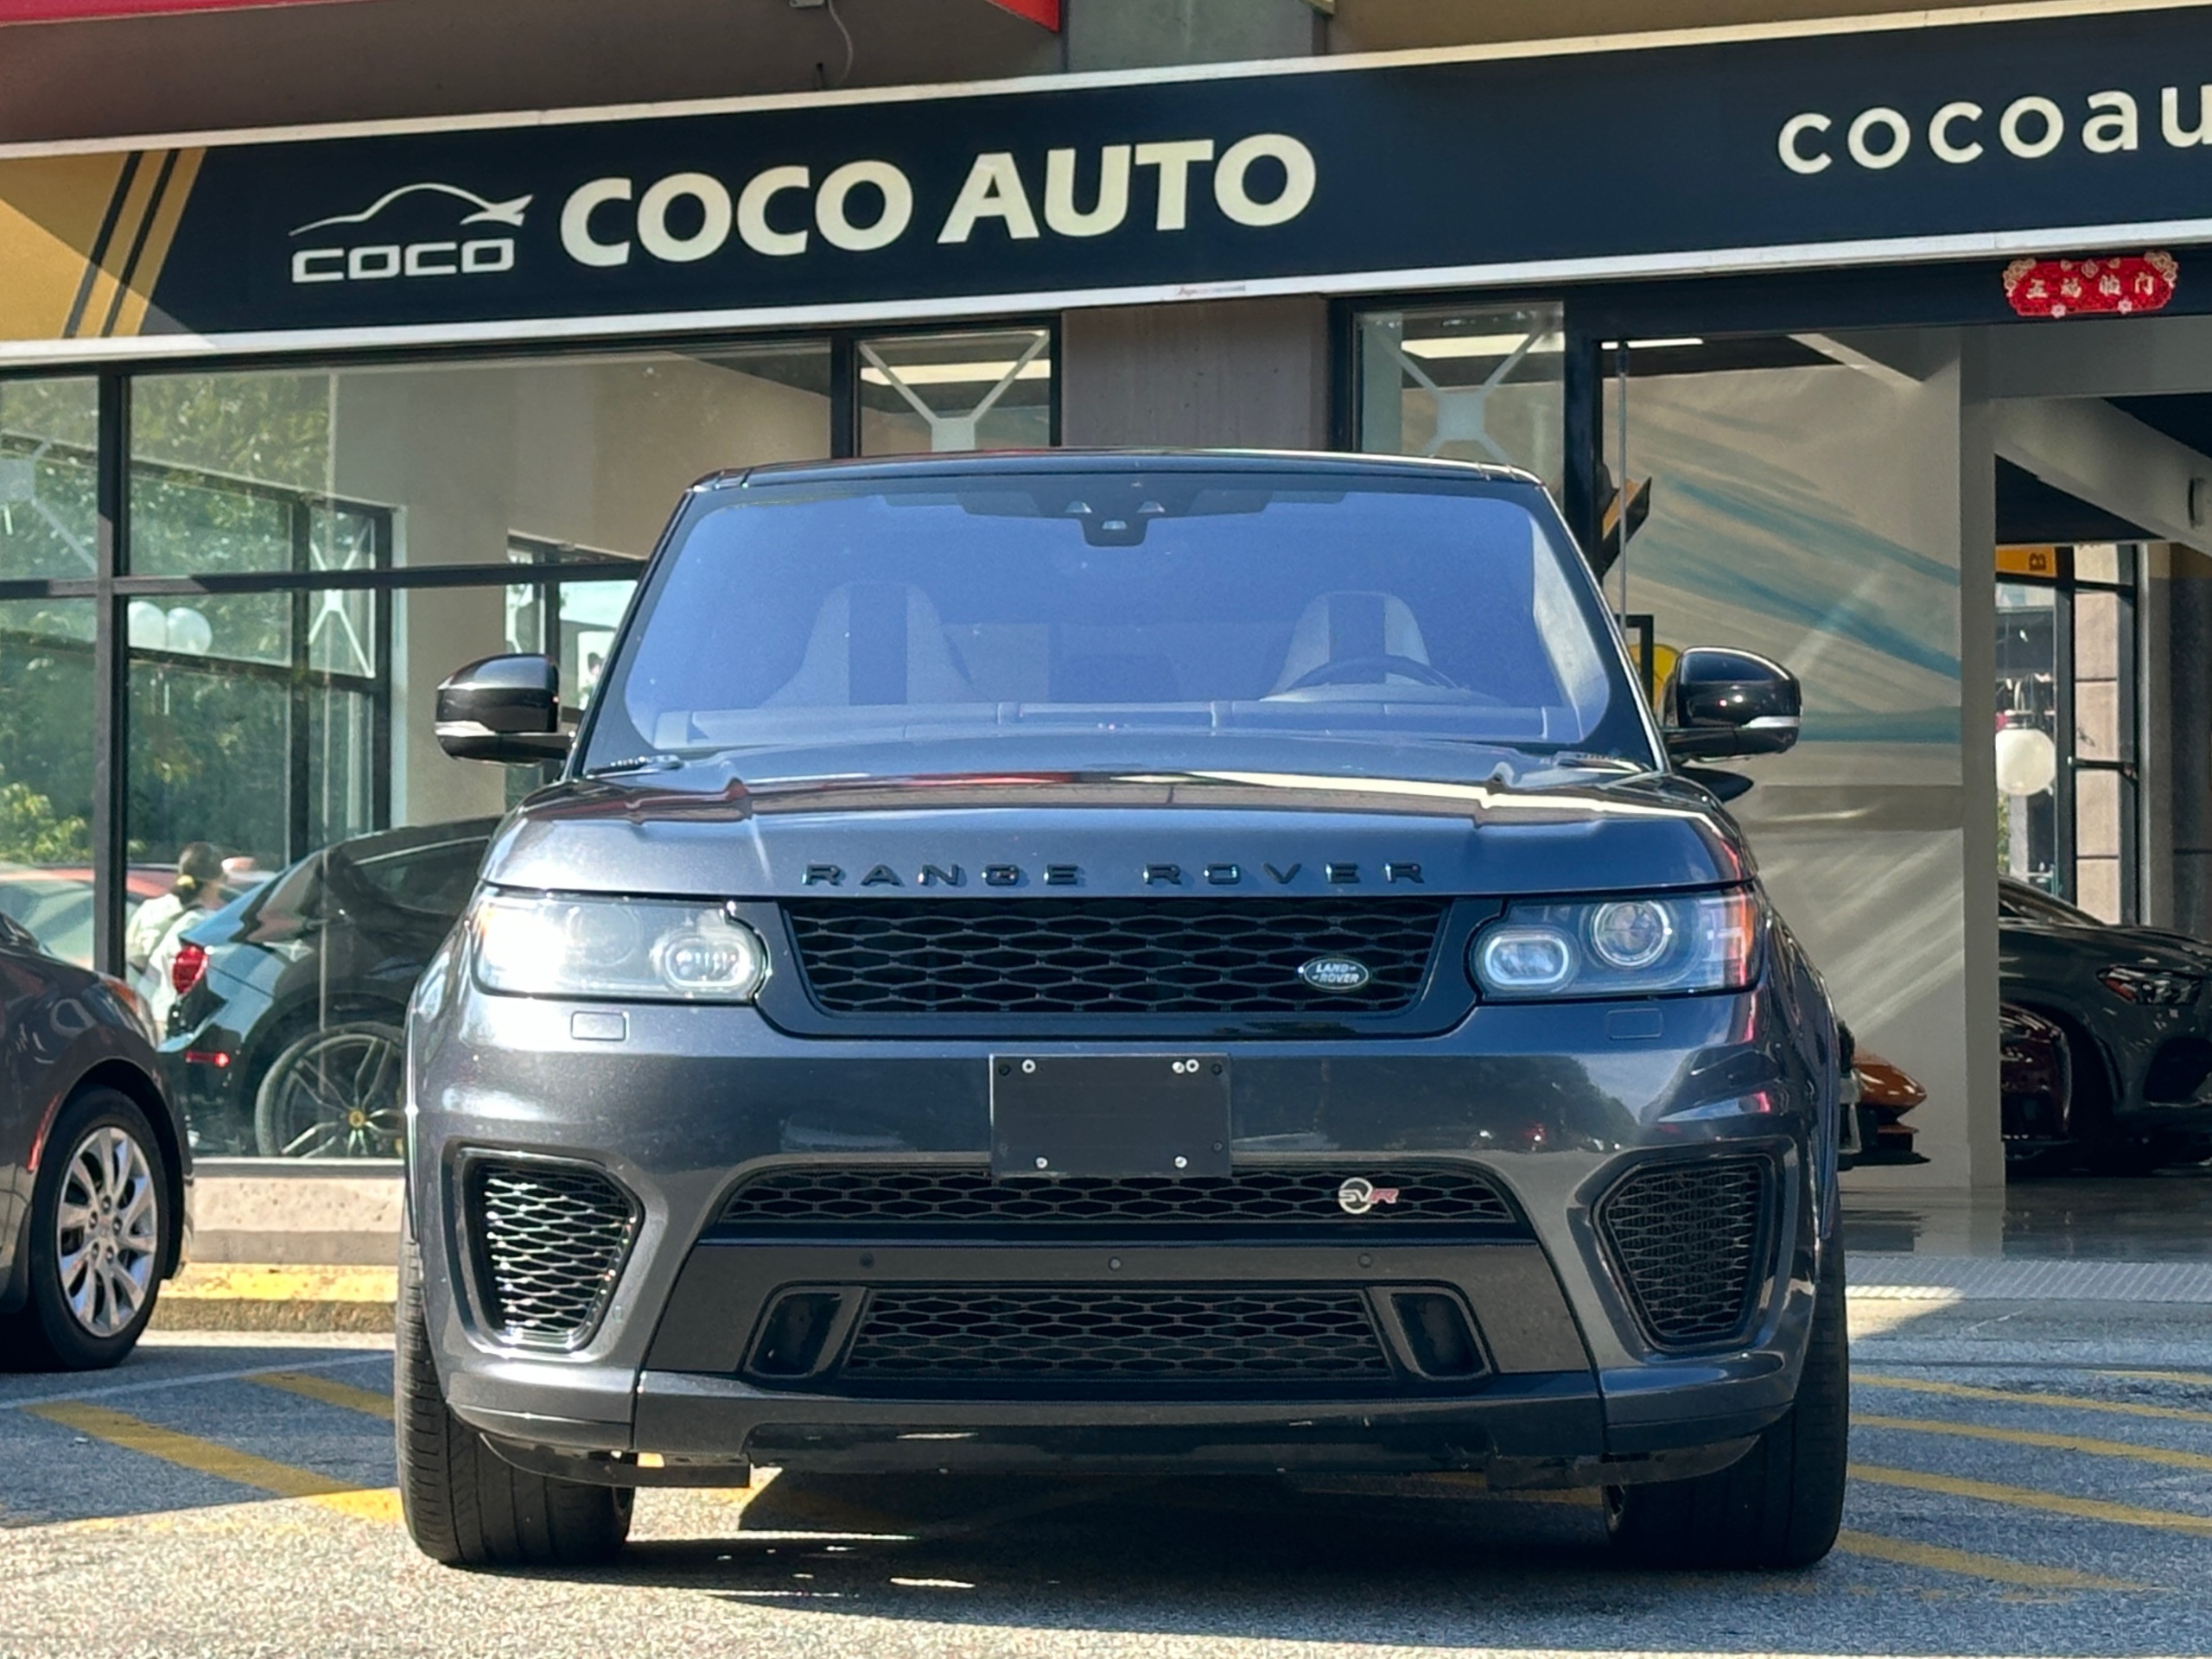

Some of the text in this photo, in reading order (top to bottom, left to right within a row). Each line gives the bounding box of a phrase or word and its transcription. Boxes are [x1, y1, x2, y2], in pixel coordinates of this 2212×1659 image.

[562, 134, 1317, 266] COCO AUTO
[292, 238, 514, 283] COCO
[802, 862, 1426, 887] RANGE ROVER
